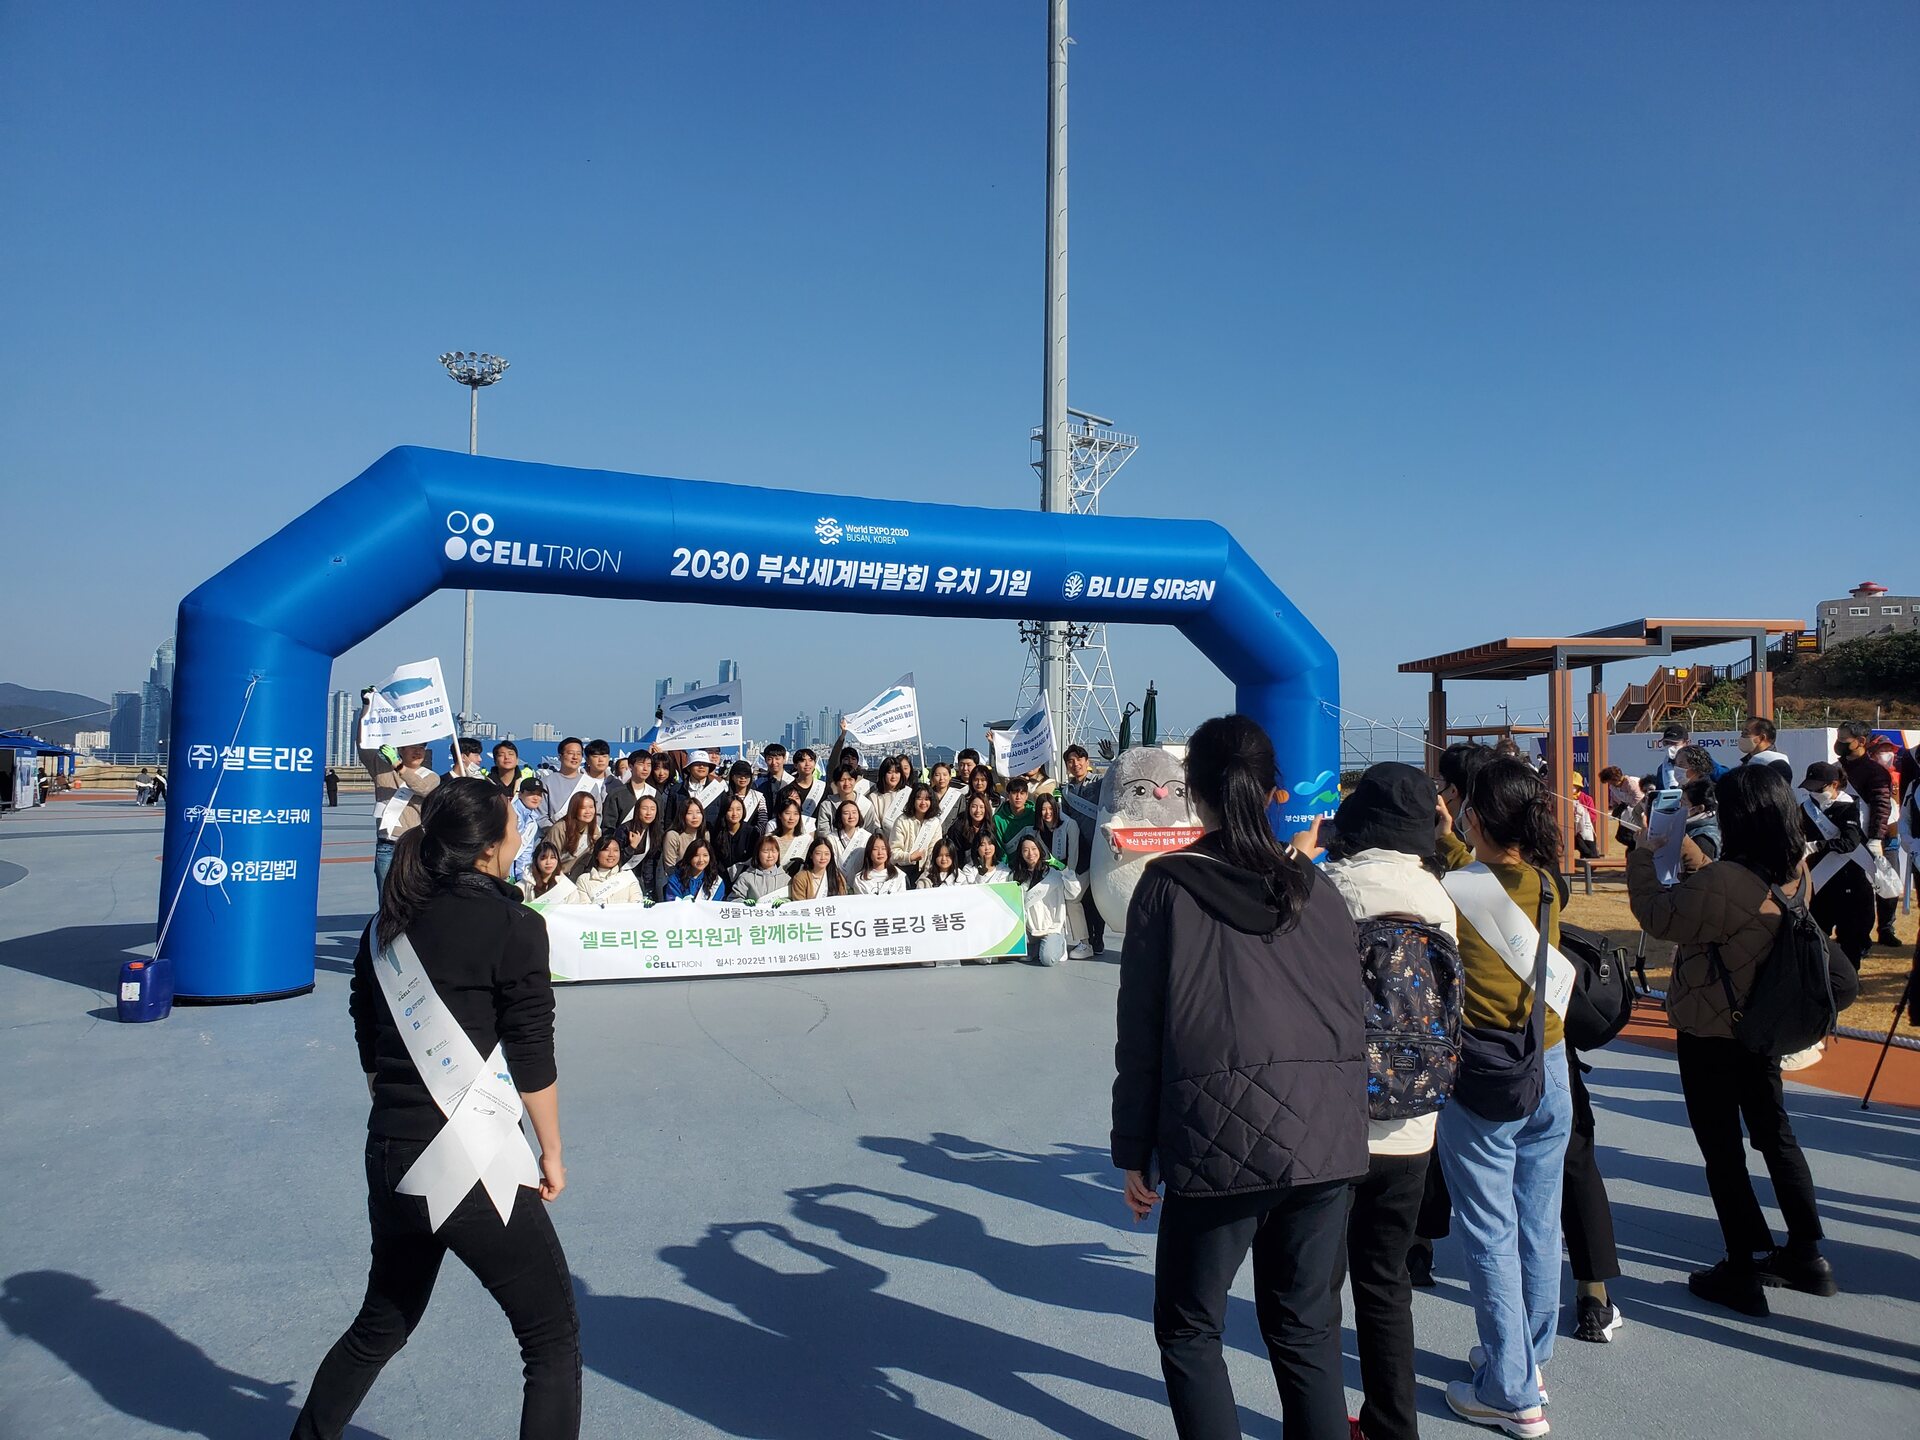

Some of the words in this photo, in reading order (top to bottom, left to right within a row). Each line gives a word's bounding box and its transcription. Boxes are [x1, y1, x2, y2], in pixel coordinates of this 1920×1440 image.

[845, 525, 868, 534] World
[869, 526, 890, 535] EXPO
[890, 528, 909, 536] 2030
[846, 534, 872, 544] BUSAN,
[873, 535, 897, 544] KOREA
[470, 538, 622, 573] CELLTRION
[670, 547, 750, 581] 2030
[756, 554, 930, 592] 부산세계박람회
[934, 567, 981, 594] 유치
[985, 569, 1031, 597] 기원
[1087, 576, 1149, 599] BLUE
[1150, 578, 1216, 601] SIREN
[1697, 739, 1721, 748] BPA
[187, 745, 313, 772] (주)셀트리온
[230, 859, 297, 881] 유한킴벌리
[814, 905, 837, 917] 위한
[580, 929, 659, 949] 셀트리온
[665, 926, 743, 949] 임직원과
[749, 922, 824, 945] 함께하는
[830, 920, 867, 939] ESG
[872, 915, 926, 938] 플로깅
[931, 912, 966, 932] 활동
[653, 960, 703, 969] CELLTRION
[737, 956, 767, 966] 2022년
[768, 955, 788, 965] 11월
[788, 952, 820, 963] 26일(토)
